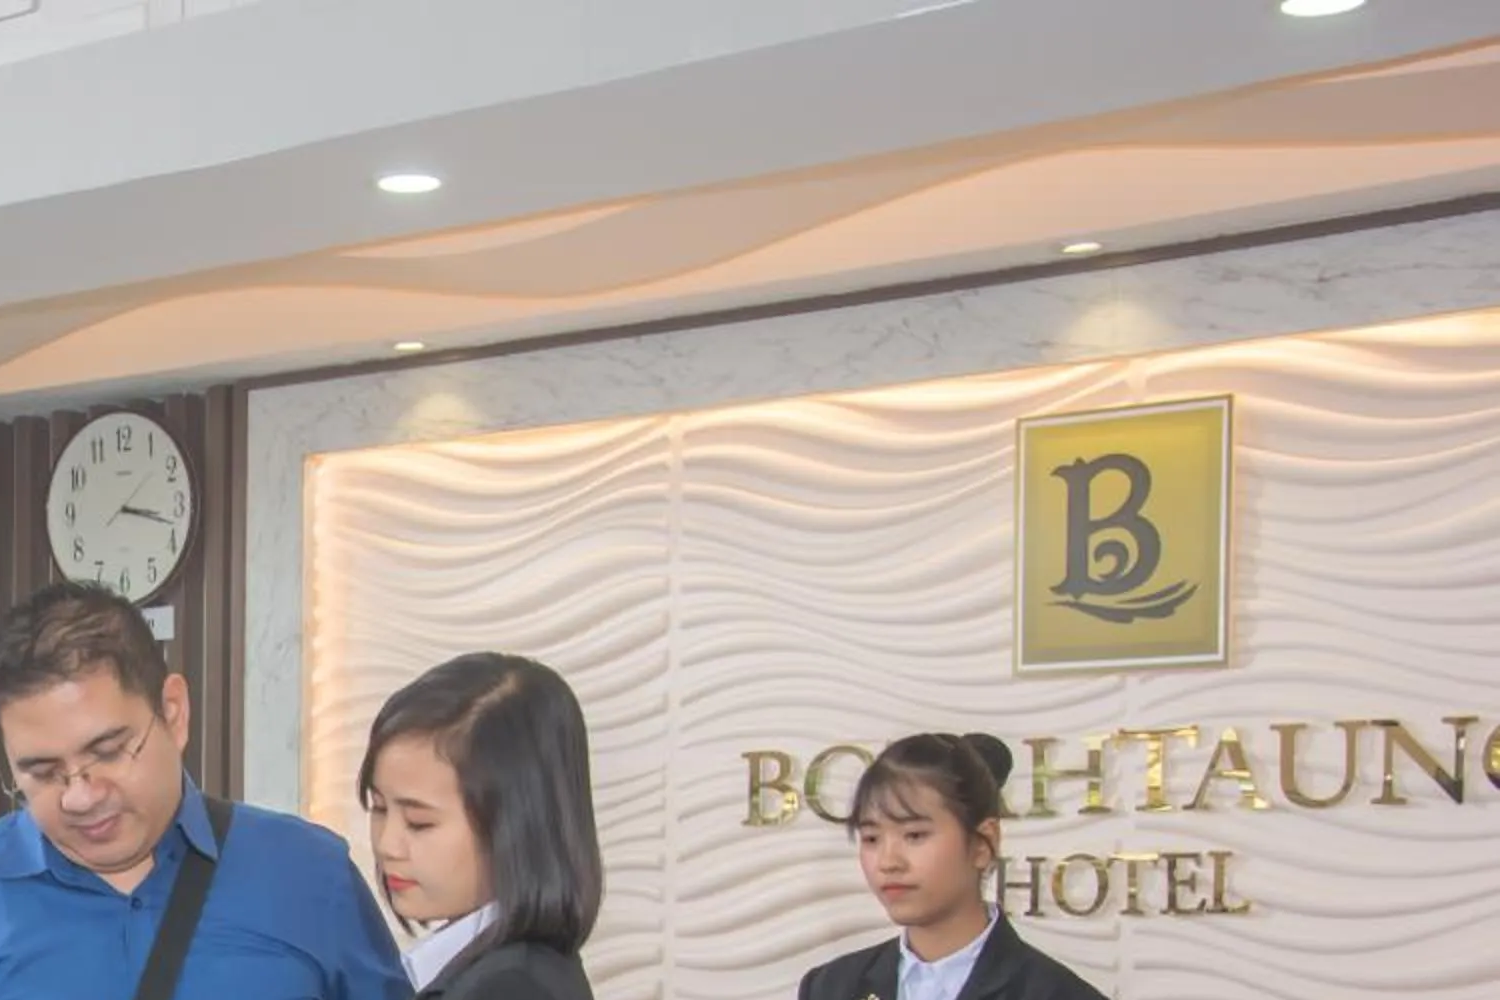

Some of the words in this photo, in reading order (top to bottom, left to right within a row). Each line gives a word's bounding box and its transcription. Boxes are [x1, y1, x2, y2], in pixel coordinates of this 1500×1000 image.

[91, 437, 104, 464] 11
[116, 425, 132, 452] 12
[71, 464, 86, 492] 10
[165, 455, 177, 482] 2
[65, 502, 75, 527] 9
[174, 491, 185, 518] 3
[1049, 453, 1162, 599] B
[73, 537, 84, 562] 8
[167, 528, 176, 555] 4
[94, 561, 104, 584] 7
[120, 567, 131, 594] 6
[148, 557, 157, 584] 5
[741, 716, 1500, 827] BOHTAUN
[996, 850, 1250, 918] HOTEL
